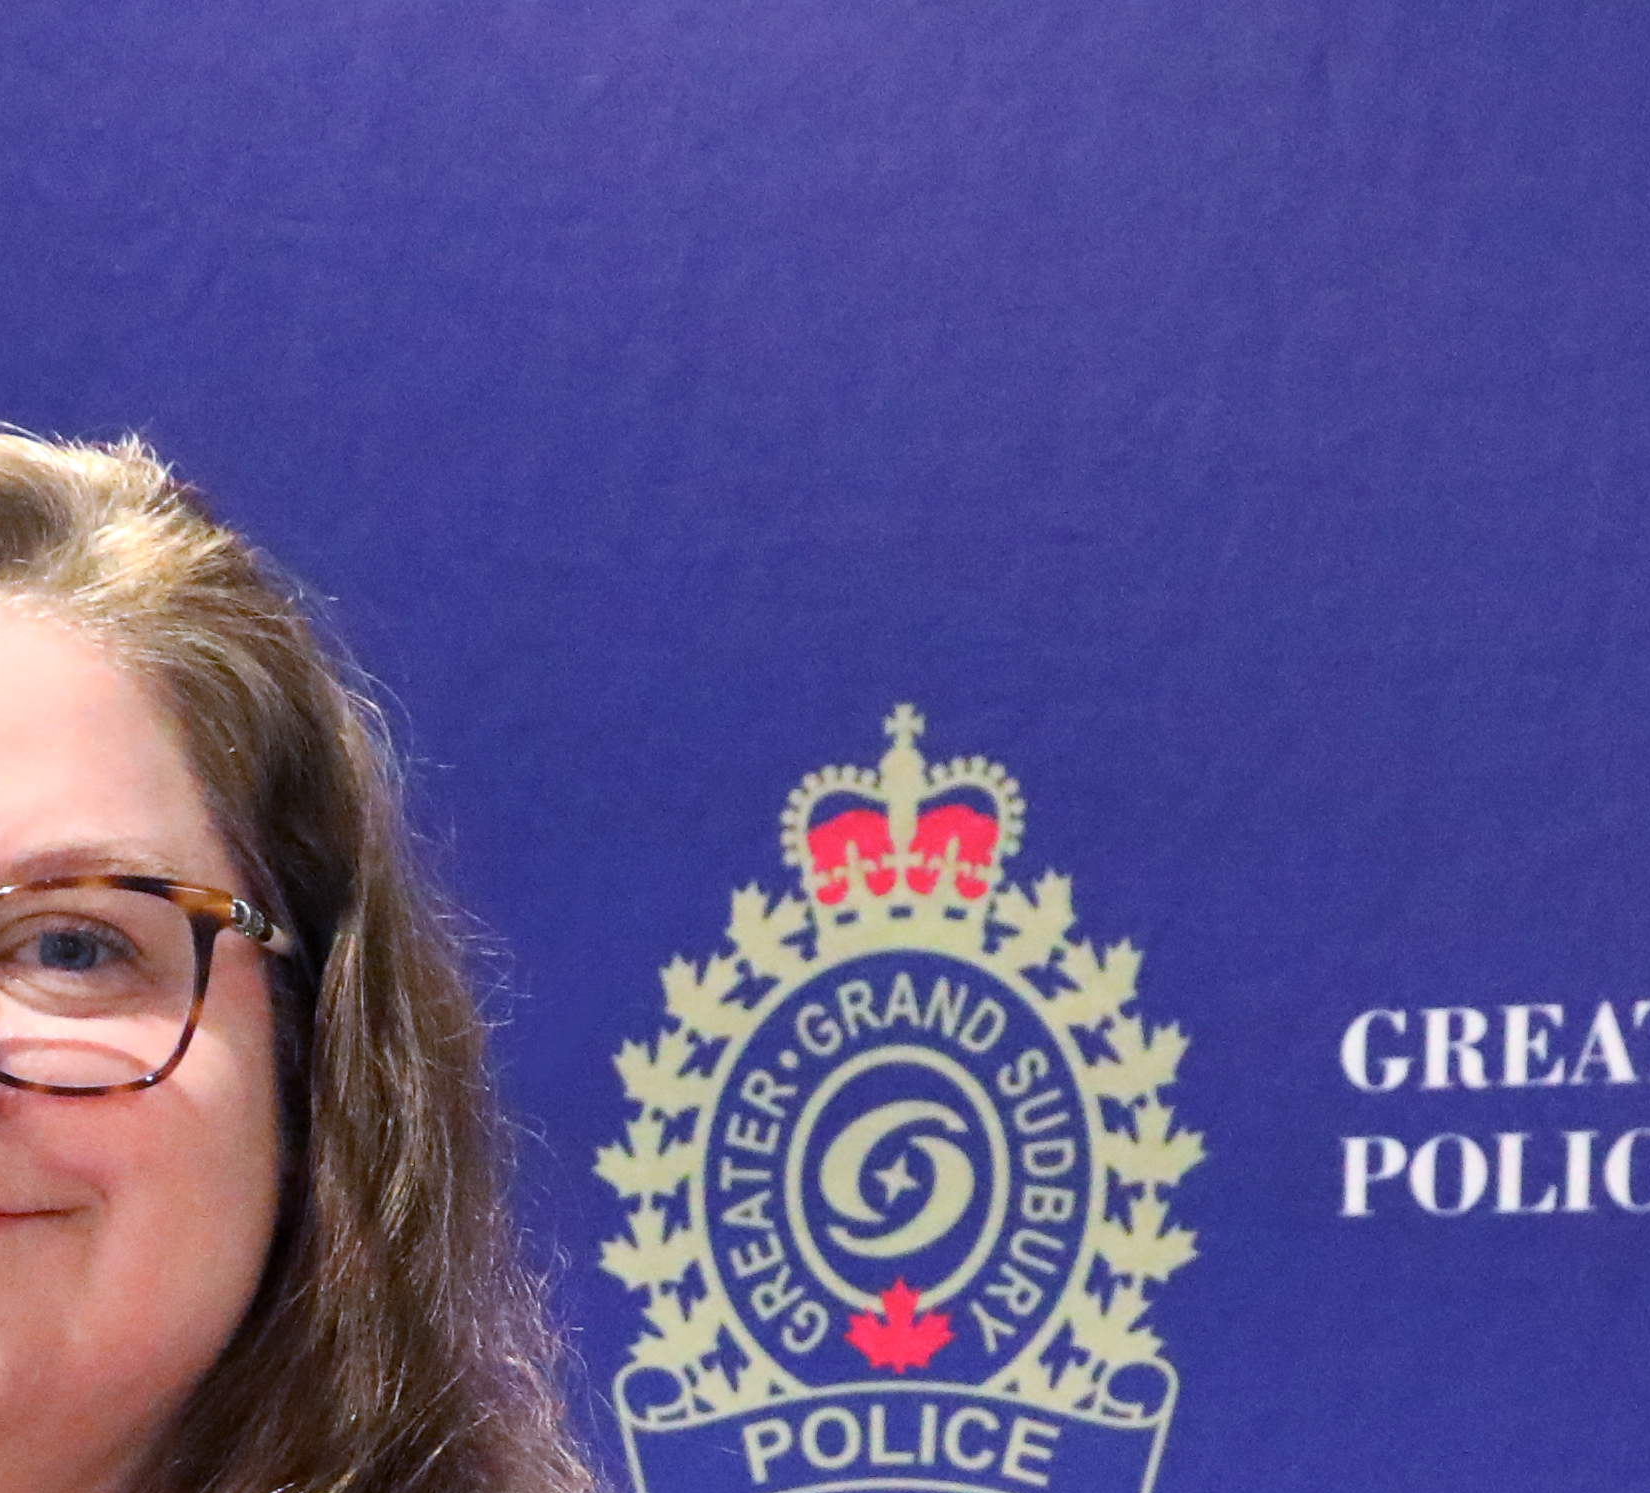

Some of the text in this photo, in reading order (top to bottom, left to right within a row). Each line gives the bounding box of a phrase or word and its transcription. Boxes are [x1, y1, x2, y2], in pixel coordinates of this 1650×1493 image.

[720, 972, 1074, 1353] GREATER GRAND SUDBURY
[741, 1404, 1061, 1486] POLICE
